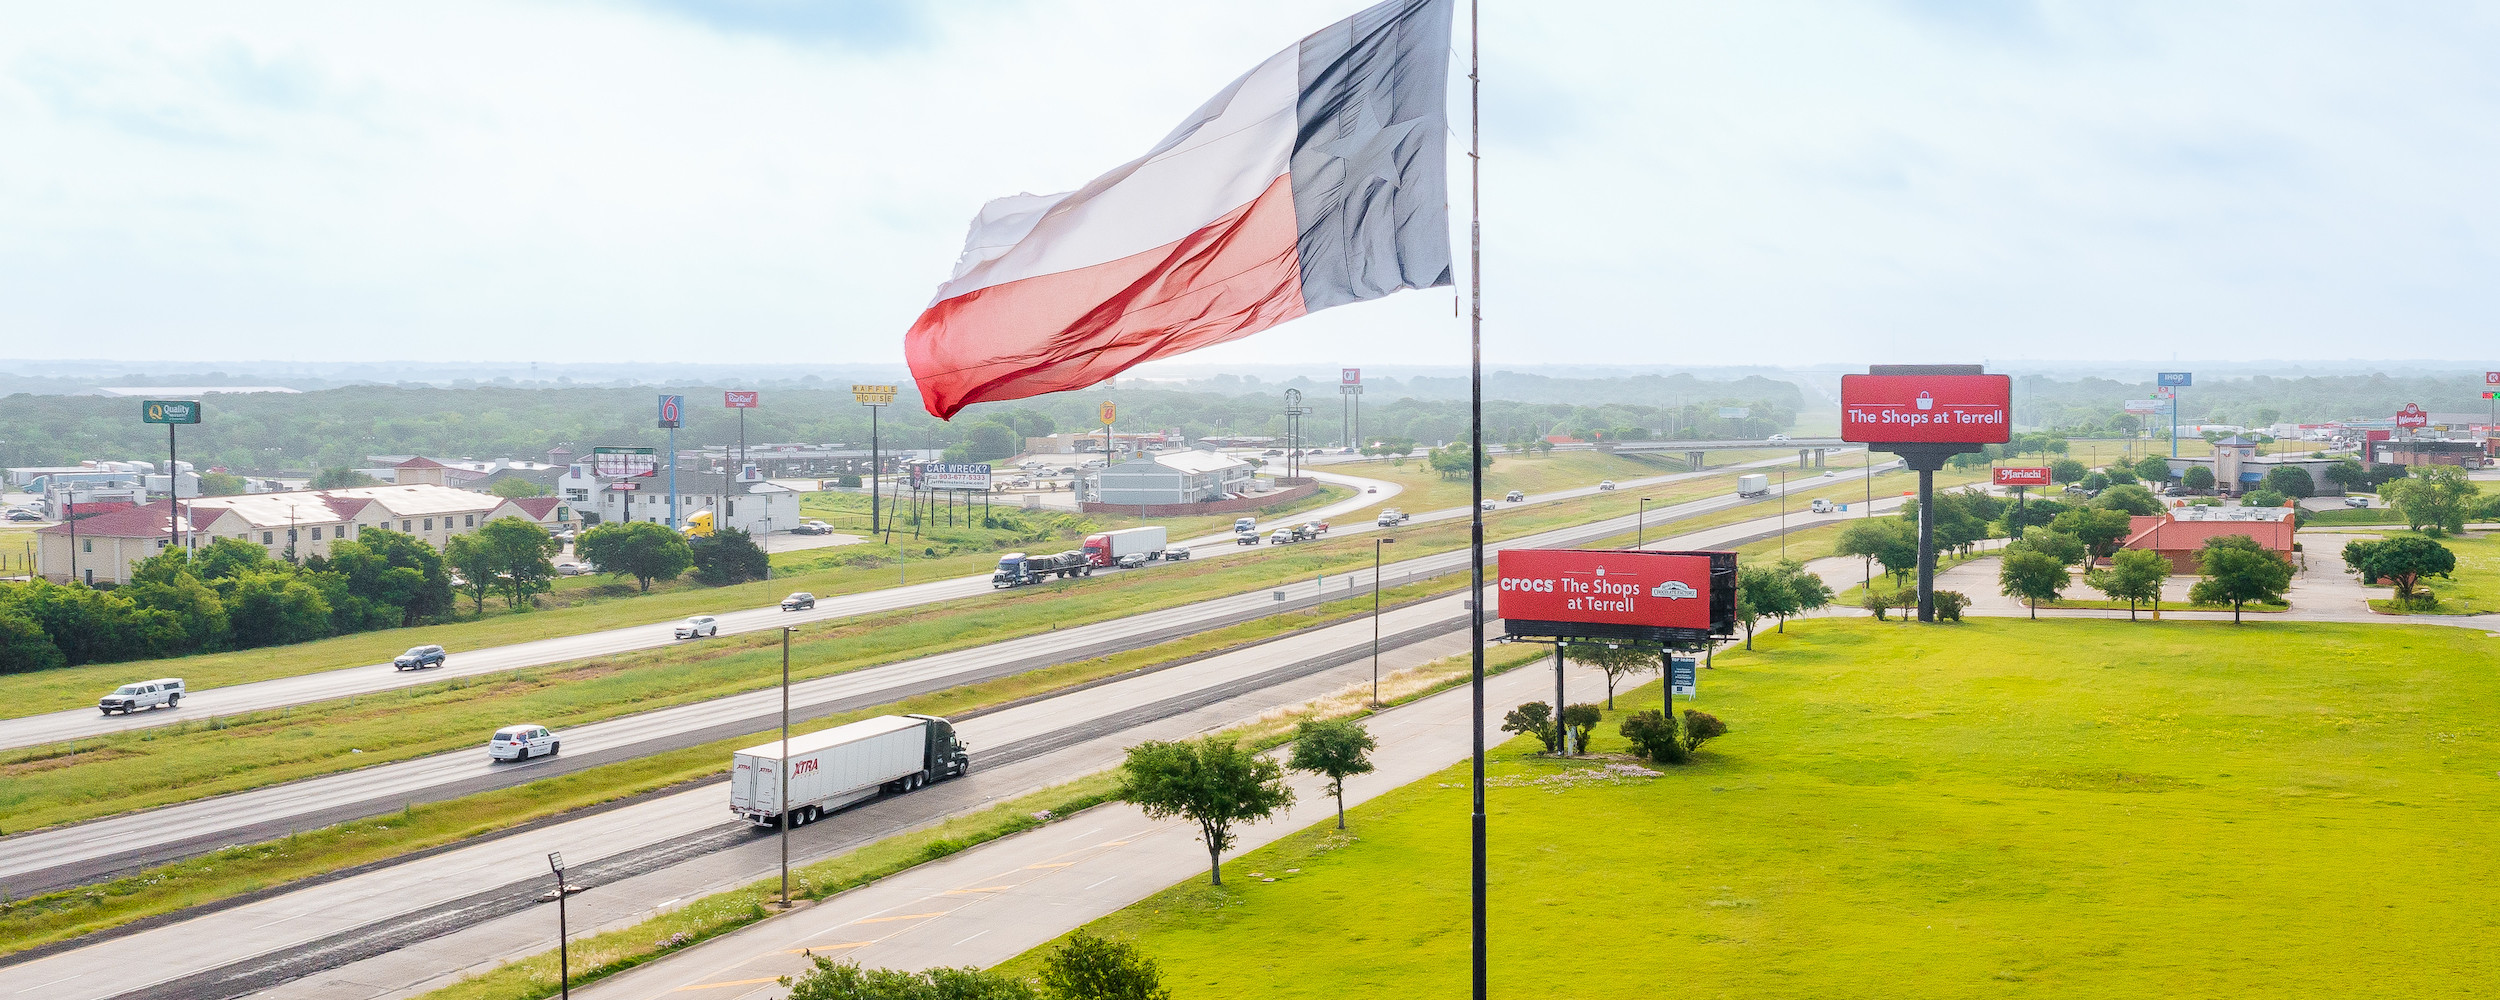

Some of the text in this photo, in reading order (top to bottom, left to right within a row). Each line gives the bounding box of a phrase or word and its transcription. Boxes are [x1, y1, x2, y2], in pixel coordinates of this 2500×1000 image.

[852, 385, 897, 393] WAFFLE
[856, 394, 892, 402] HOUSE
[164, 404, 190, 415] Quality
[662, 395, 679, 421] 6
[1848, 408, 2003, 427] The Shops at Terrell
[926, 464, 988, 474] CAR WRECK?
[2001, 469, 2042, 480] Mariachi
[1500, 577, 1554, 593] crocs
[1561, 578, 1640, 598] The Shops
[1567, 596, 1634, 612] at Terrell
[791, 758, 818, 779] XTRA
